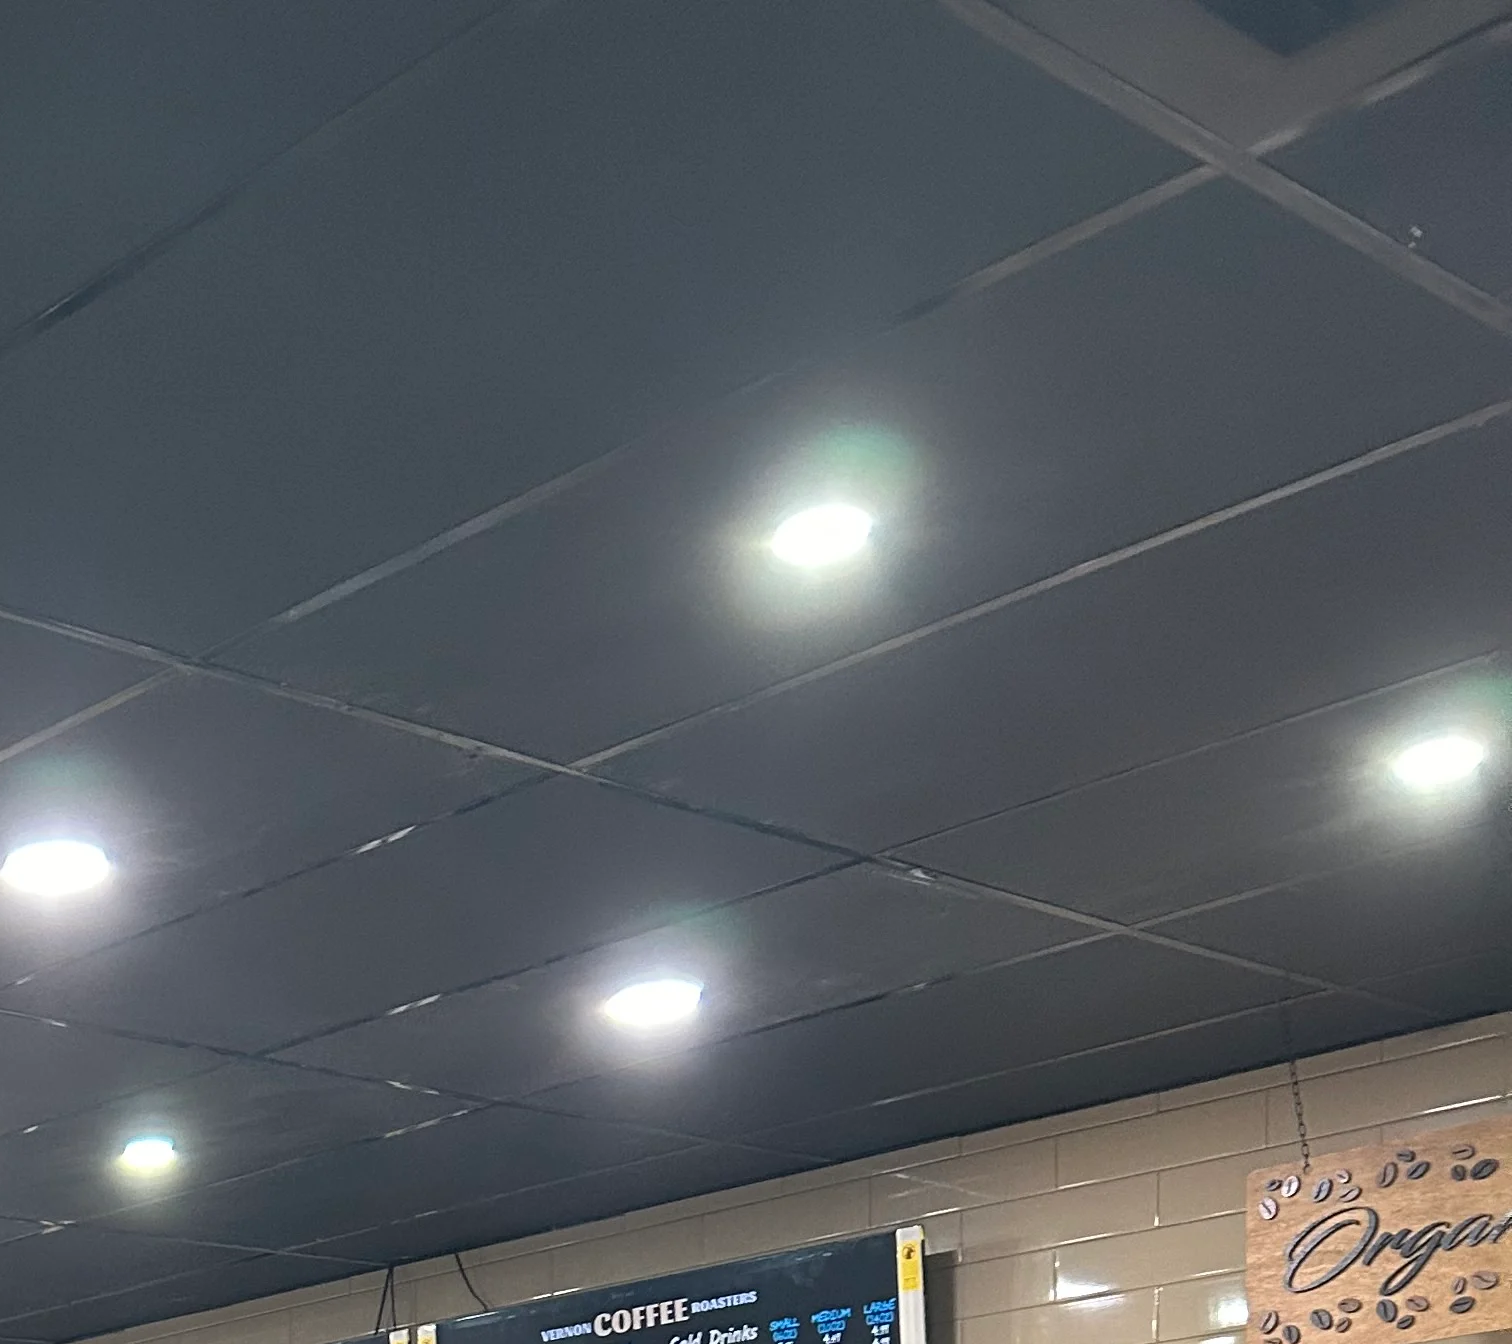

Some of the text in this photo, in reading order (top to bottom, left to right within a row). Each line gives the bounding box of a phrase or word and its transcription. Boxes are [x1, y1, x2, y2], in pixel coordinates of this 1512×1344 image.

[541, 1291, 758, 1342] VERNON COFFEE ROASTERS
